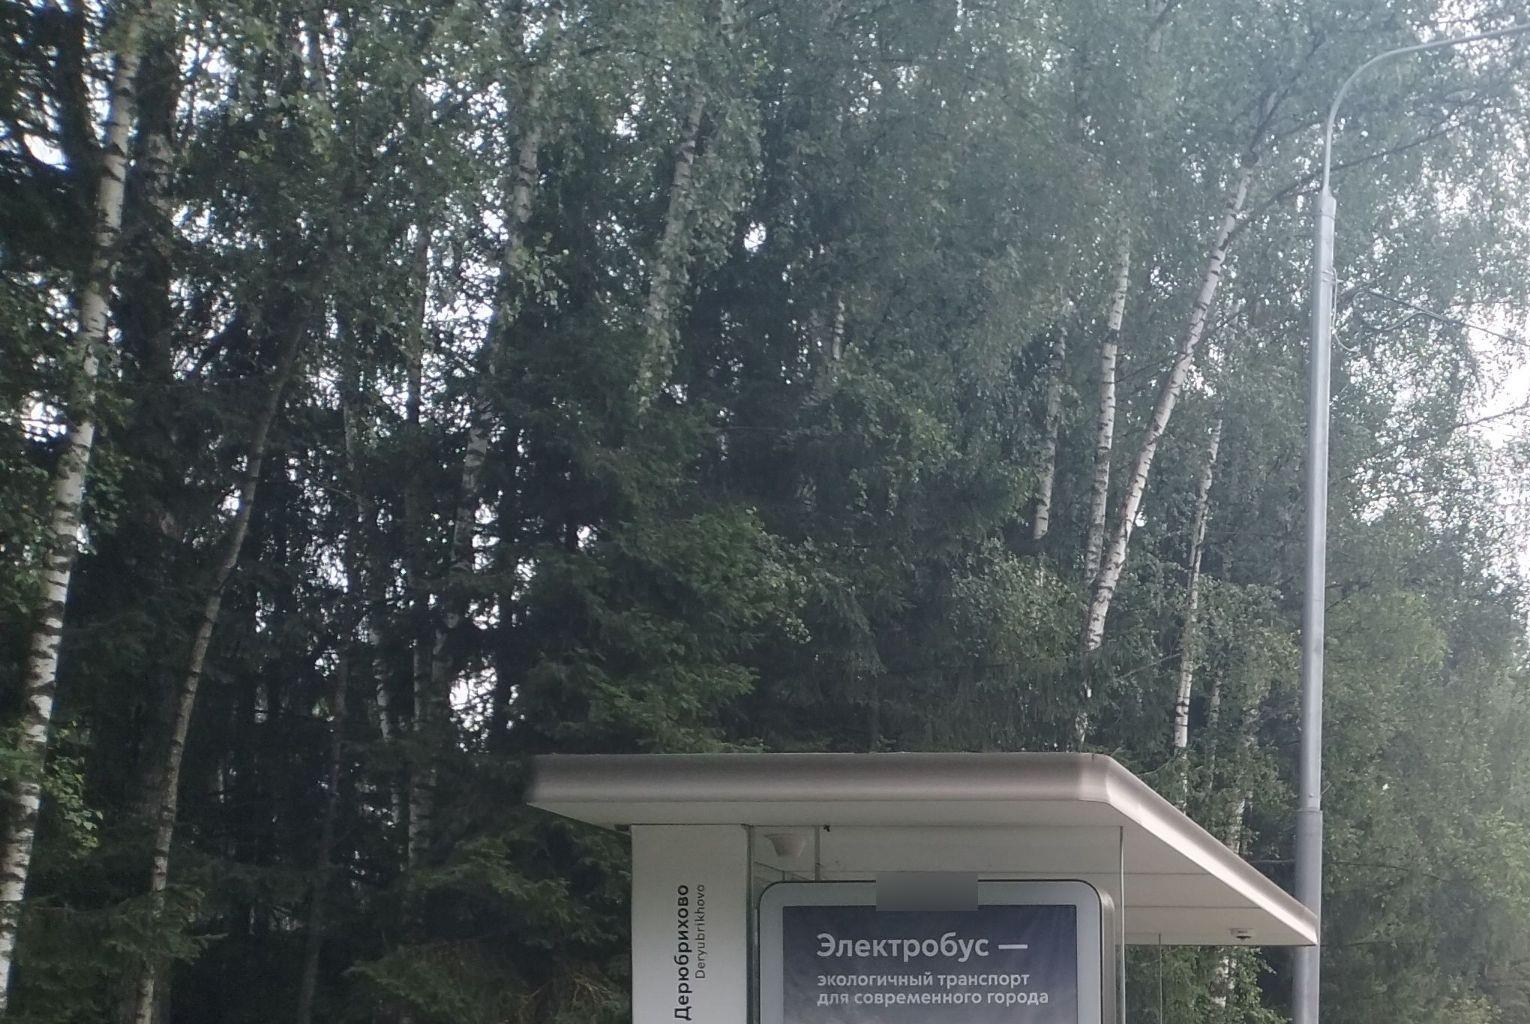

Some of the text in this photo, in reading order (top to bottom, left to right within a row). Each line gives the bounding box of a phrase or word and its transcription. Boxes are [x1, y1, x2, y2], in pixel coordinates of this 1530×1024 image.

[695, 884, 707, 979] Deryubrikhovo
[674, 884, 692, 1021] Дерюбрихово
[816, 932, 989, 963] Электробус
[817, 971, 1030, 988] экологичный транспорт
[817, 990, 1049, 1007] для современного города
